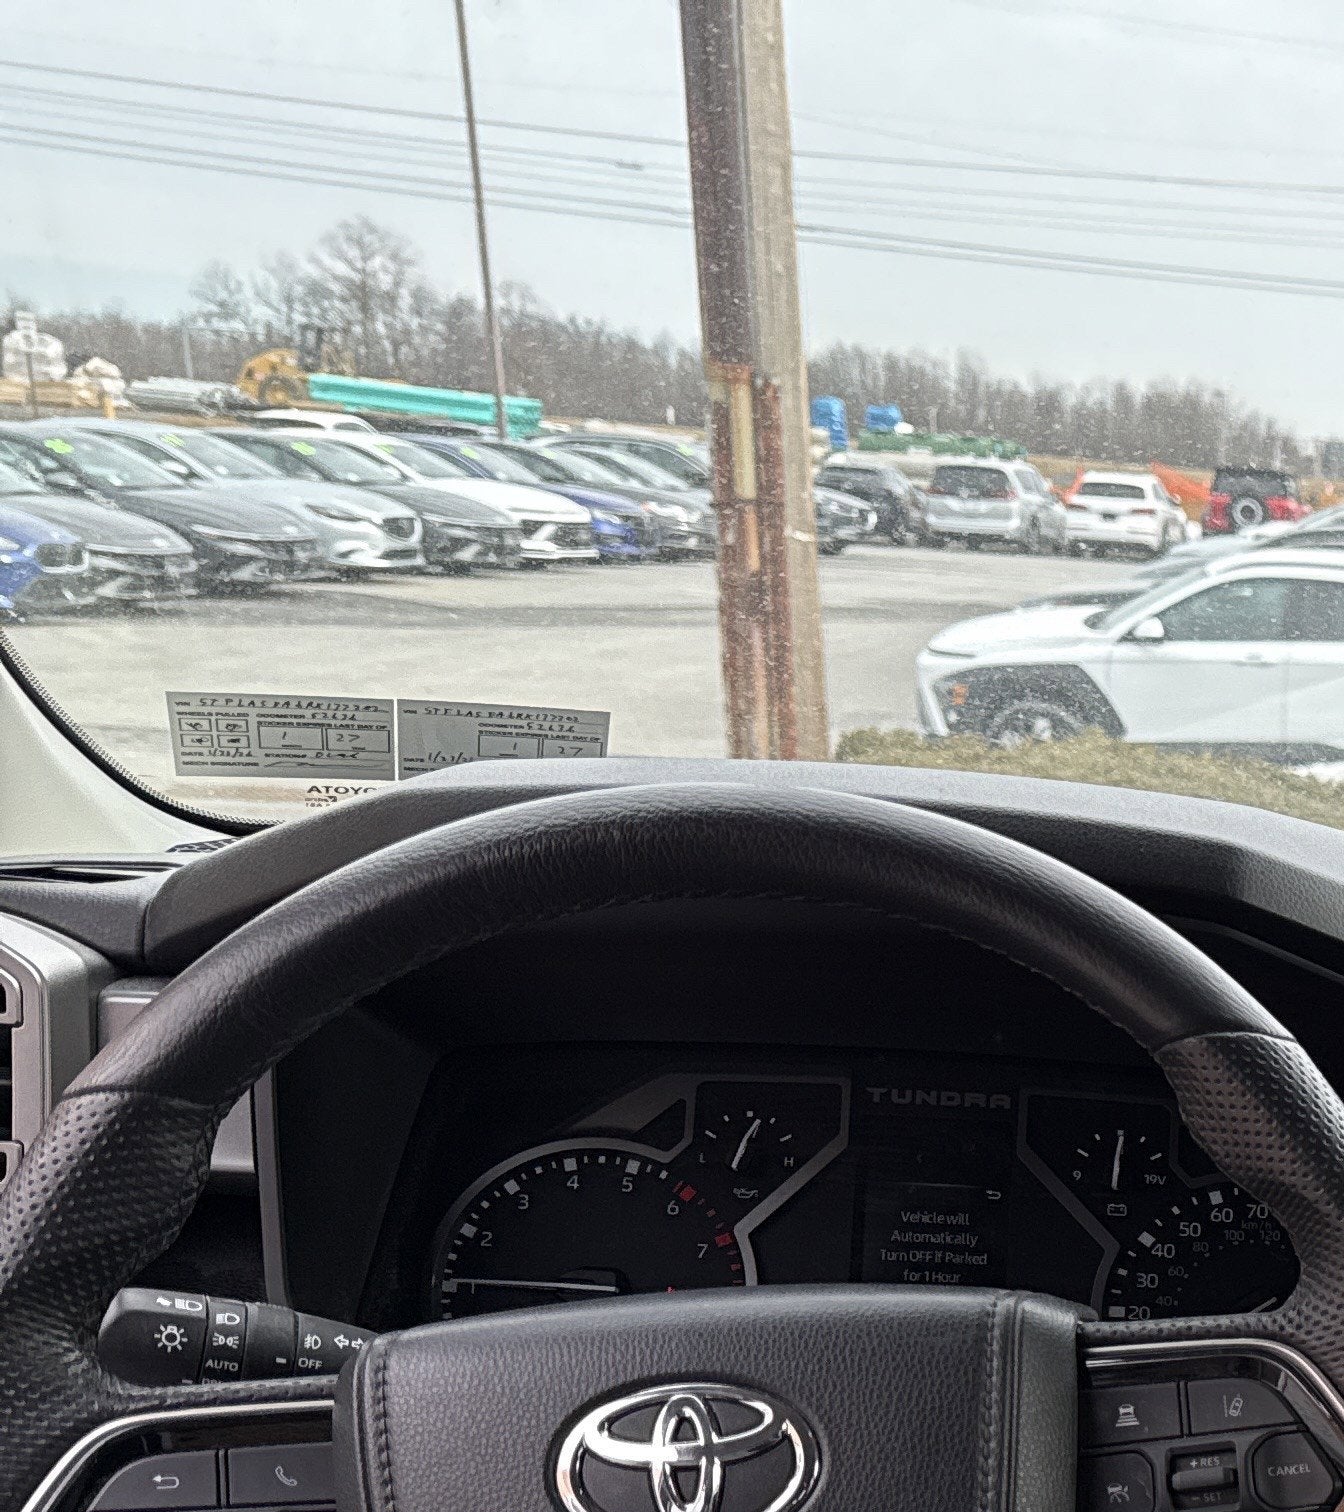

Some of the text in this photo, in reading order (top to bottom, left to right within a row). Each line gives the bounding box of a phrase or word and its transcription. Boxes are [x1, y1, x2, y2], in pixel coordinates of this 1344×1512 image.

[866, 1087, 1012, 1110] TUNDRA
[567, 1174, 580, 1190] 4
[621, 1177, 634, 1193] 5
[518, 1194, 529, 1210] 3
[666, 1200, 680, 1216] 6
[901, 1210, 970, 1226] Vehicle will
[1210, 1207, 1235, 1223] 60
[1246, 1203, 1269, 1220] 70
[1179, 1221, 1202, 1238] 50
[480, 1231, 492, 1247] 2
[890, 1229, 980, 1249] Automatically
[696, 1243, 709, 1259] 7
[880, 1249, 908, 1262] Turn
[945, 1251, 988, 1266] Parked
[1150, 1243, 1175, 1259] 40
[902, 1268, 922, 1283] for
[931, 1271, 961, 1284] Hour
[1136, 1272, 1159, 1289] 30
[1128, 1305, 1151, 1321] 20
[205, 1358, 239, 1372] AUTO
[298, 1357, 324, 1370] OFF
[1267, 1463, 1311, 1478] CANCEL
